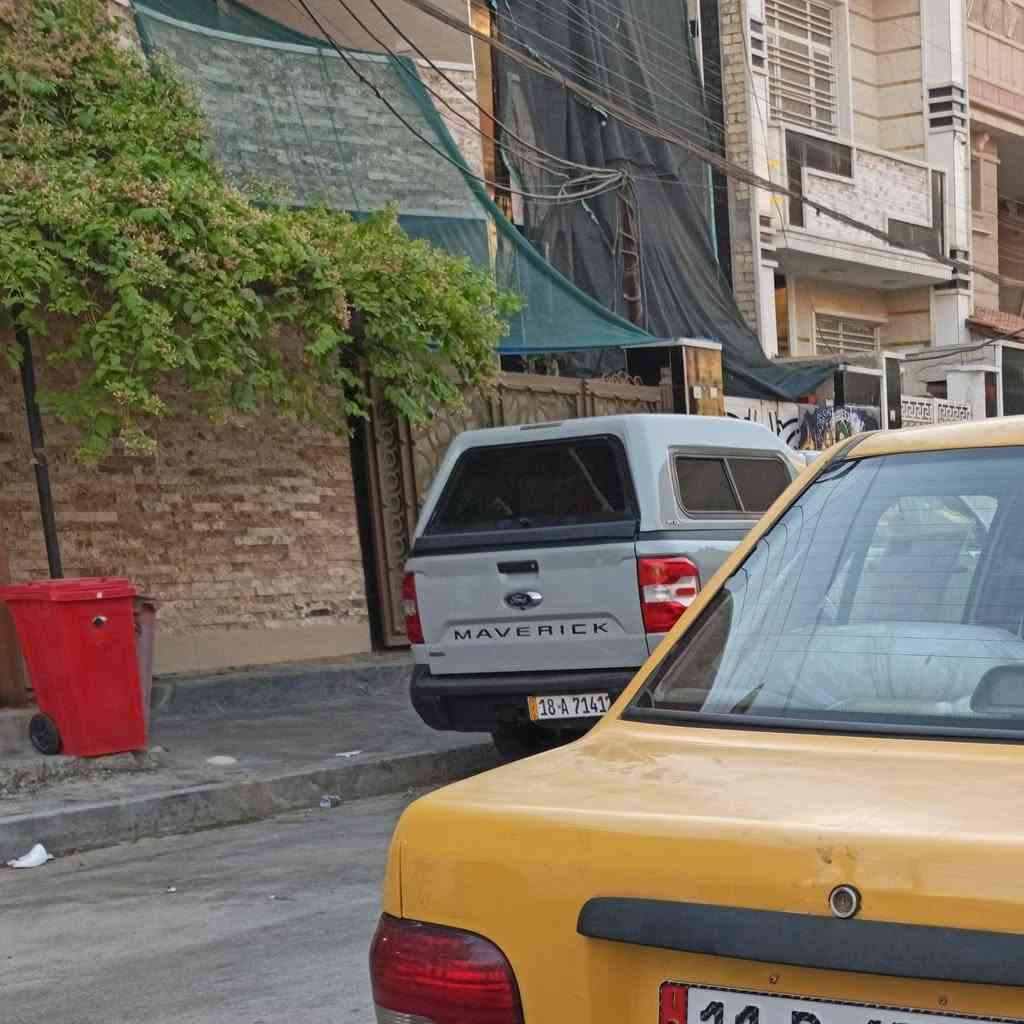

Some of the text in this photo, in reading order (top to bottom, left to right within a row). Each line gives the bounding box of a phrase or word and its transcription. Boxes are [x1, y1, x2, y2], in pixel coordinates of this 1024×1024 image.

[454, 622, 609, 641] MAVERICK
[539, 698, 556, 716] 18
[561, 698, 569, 715] A
